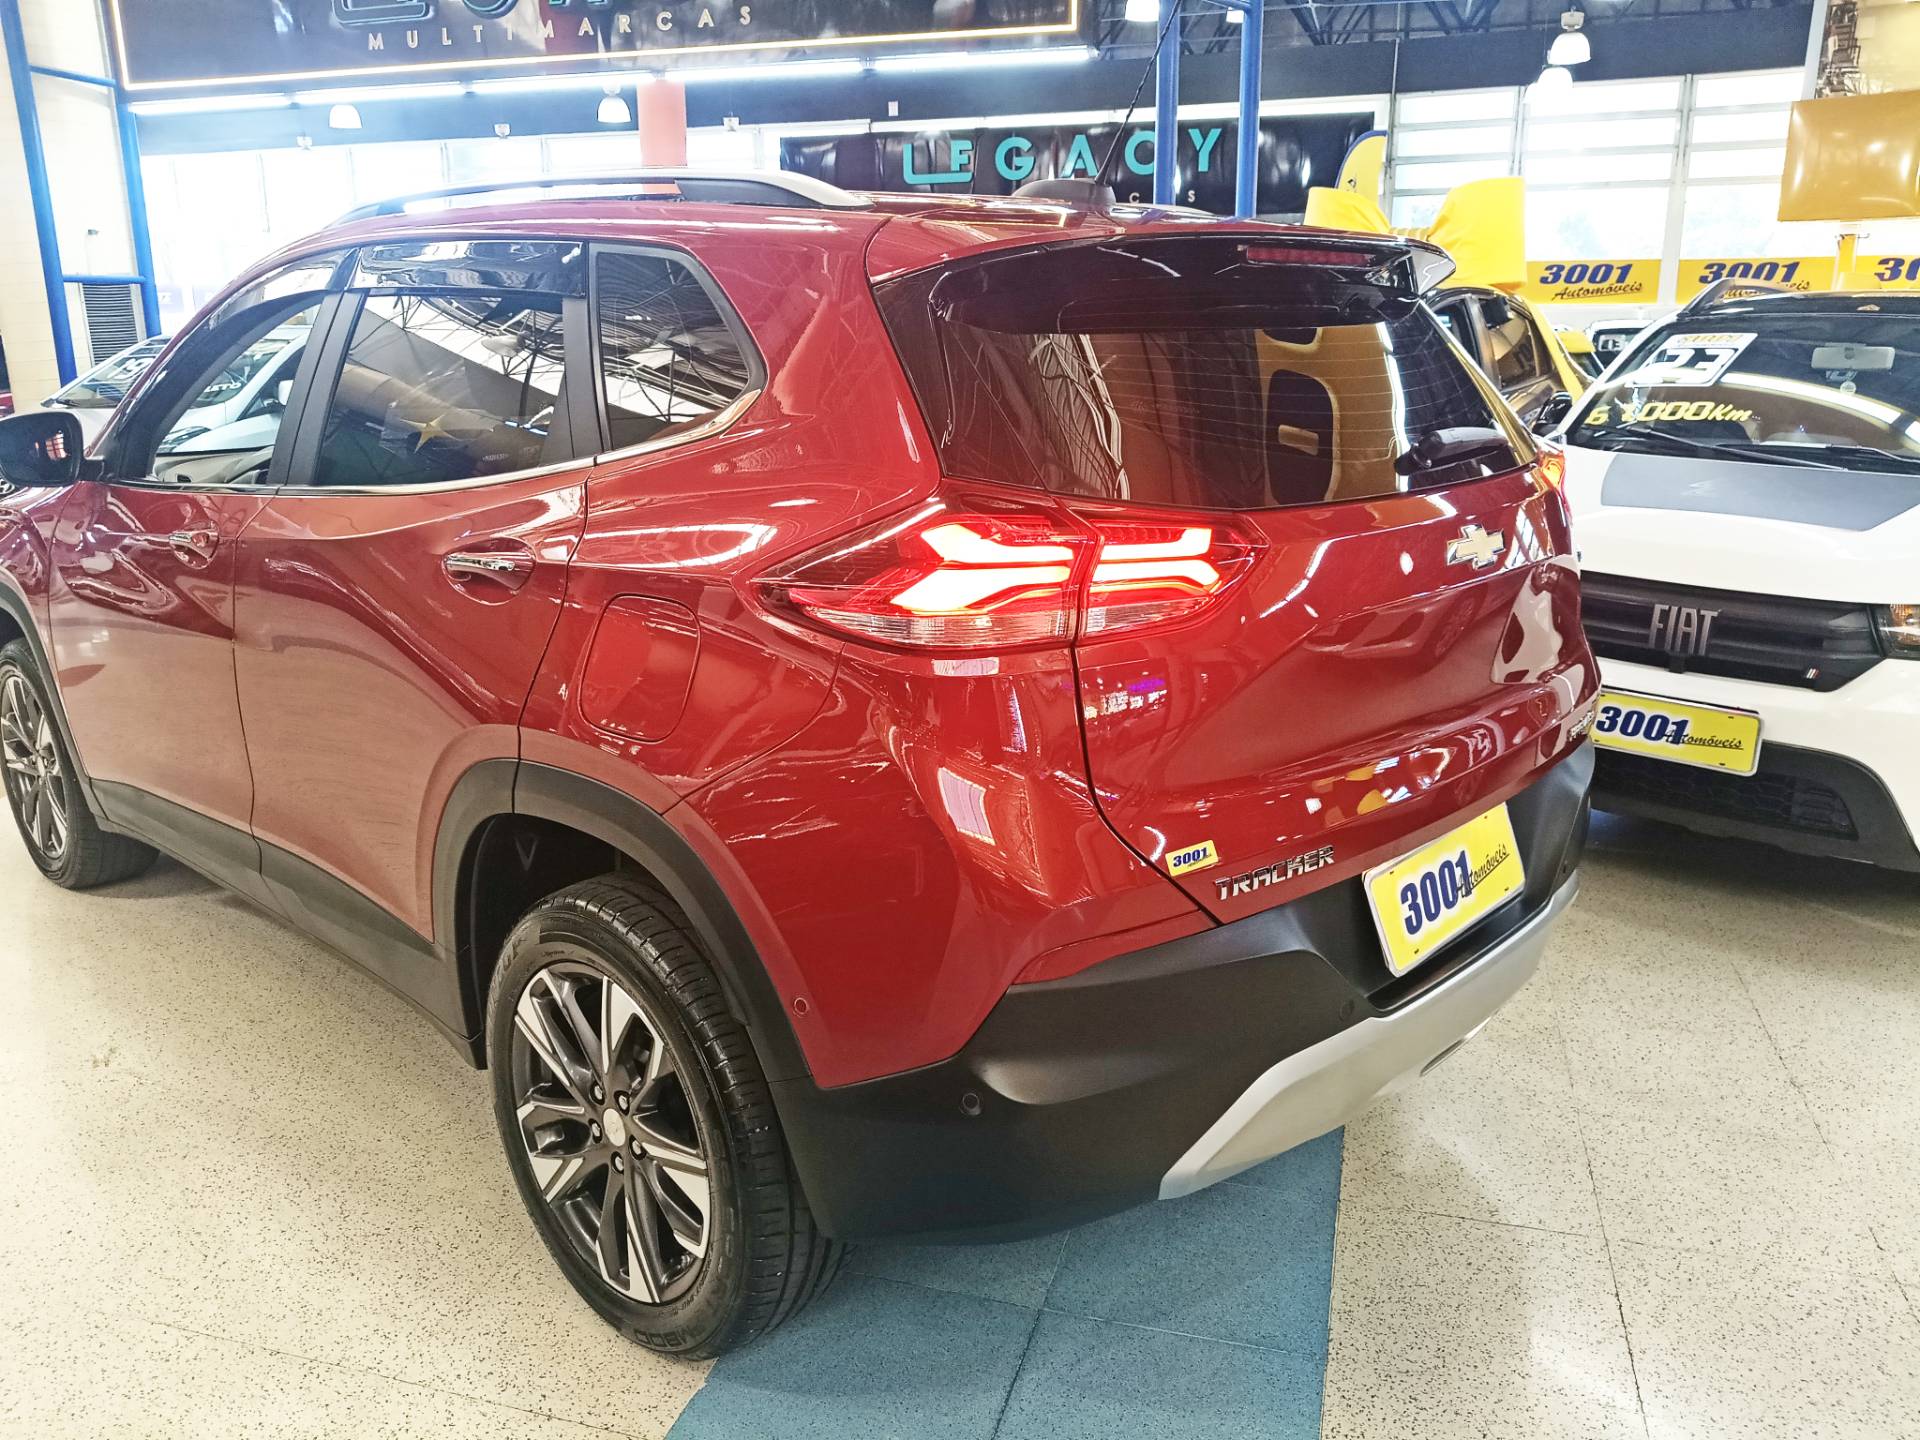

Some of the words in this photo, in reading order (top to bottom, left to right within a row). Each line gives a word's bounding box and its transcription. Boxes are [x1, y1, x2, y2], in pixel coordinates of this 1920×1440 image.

[367, 6, 752, 51] MULTIMARCAS
[903, 128, 1222, 184] LEGACY
[1540, 263, 1633, 285] 3001
[1699, 261, 1800, 284] 3001
[1649, 603, 1719, 657] FIAT
[1595, 705, 1689, 745] 3001
[1173, 847, 1207, 867] 3001
[1213, 844, 1336, 901] TRACKER
[1400, 850, 1473, 935] 3001
